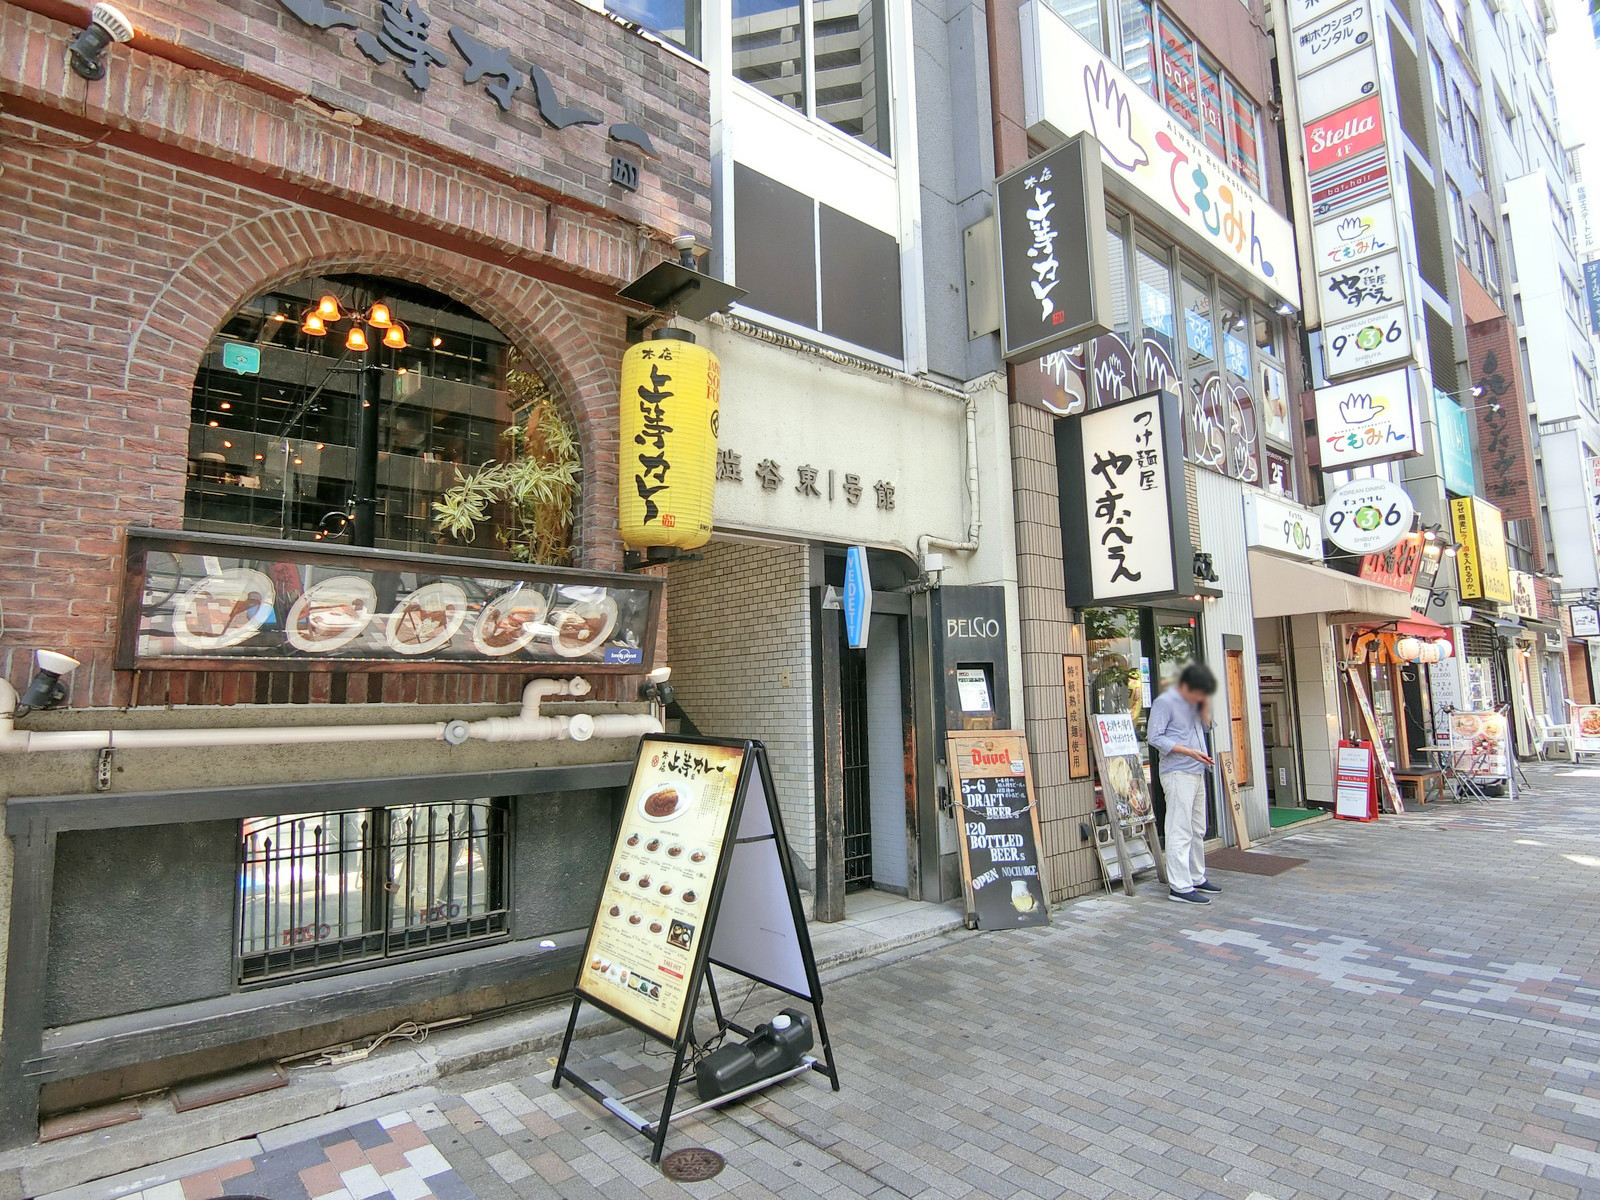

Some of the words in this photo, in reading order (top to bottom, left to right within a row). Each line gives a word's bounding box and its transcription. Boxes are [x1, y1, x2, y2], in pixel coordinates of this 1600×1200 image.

[1312, 27, 1353, 54] レンタル
[1312, 116, 1375, 153] Stella
[1166, 120, 1202, 157] Always
[1206, 154, 1254, 203] Relaxation
[1024, 167, 1053, 189] 本店
[1155, 131, 1275, 278] てもみん
[1026, 187, 1060, 323] 上等カレー
[1328, 237, 1386, 262] てもみん
[1329, 274, 1393, 307] やすべえ
[1150, 311, 1166, 330] OK
[1188, 316, 1209, 337] マスク
[641, 348, 673, 361] 本店
[1193, 335, 1208, 353] OK
[1231, 357, 1244, 375] OK
[634, 364, 675, 526] 上等カレー
[1326, 425, 1406, 452] てもみん
[1133, 411, 1158, 490] つけ麺屋
[1091, 450, 1141, 583] やすべえ
[1353, 535, 1381, 544] SHIBUYA
[847, 556, 857, 637] VEDETT
[947, 617, 999, 637] BELGO
[611, 652, 623, 660] lonely
[668, 750, 726, 777] 上等カレー
[971, 748, 1011, 766] Duvel
[966, 793, 1005, 809] DRAFT
[965, 822, 987, 836] 120
[970, 834, 1024, 850] BOTTLED
[972, 867, 999, 890] OPEN
